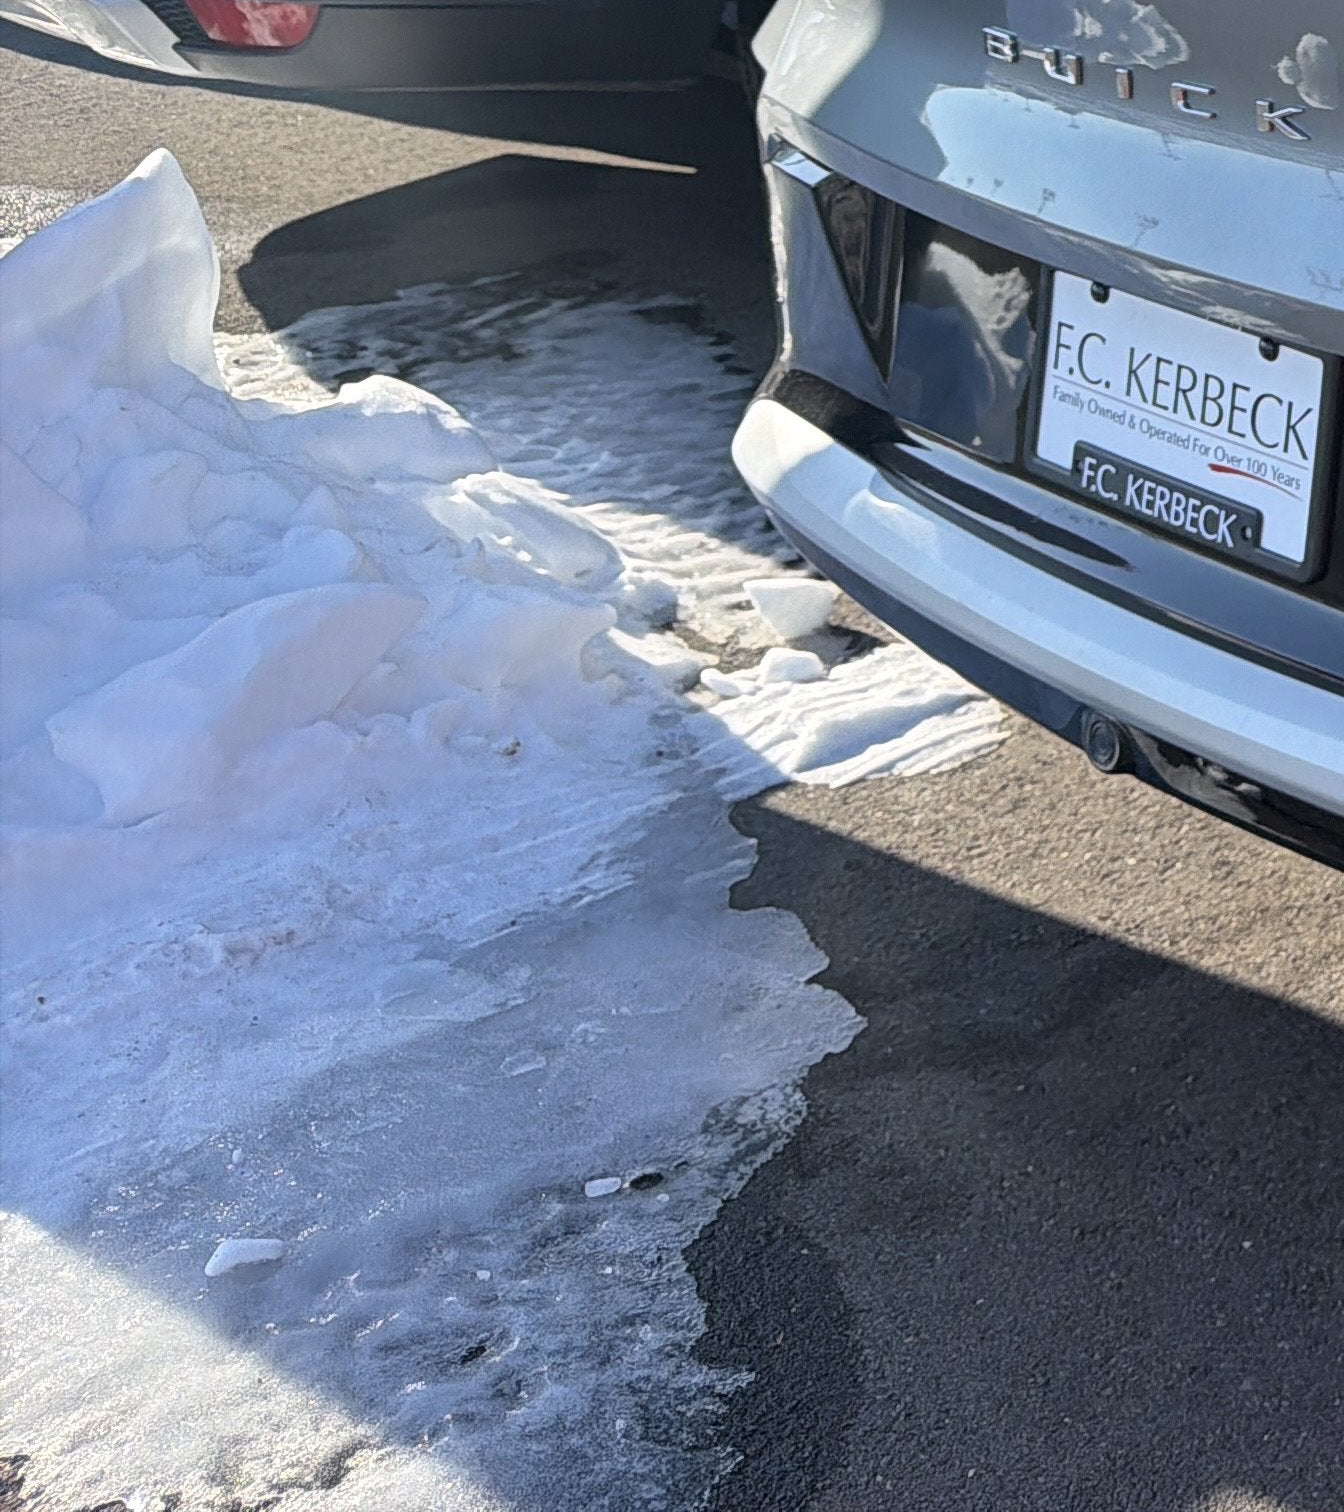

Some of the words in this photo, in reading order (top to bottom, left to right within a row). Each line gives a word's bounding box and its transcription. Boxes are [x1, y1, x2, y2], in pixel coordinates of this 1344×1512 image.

[982, 25, 1310, 141] BUICK
[1052, 321, 1111, 389] F.C.
[1126, 347, 1313, 461] KERBECK
[1053, 385, 1085, 413] Family
[1088, 398, 1127, 425] Owned
[1128, 413, 1136, 429] &
[1139, 418, 1191, 449] Operated
[1192, 437, 1211, 457] For
[1214, 446, 1242, 467] Over
[1247, 457, 1268, 477] 100
[1271, 465, 1301, 490] Years
[1081, 456, 1118, 501] F.C.
[1125, 473, 1237, 548] KERBECK
